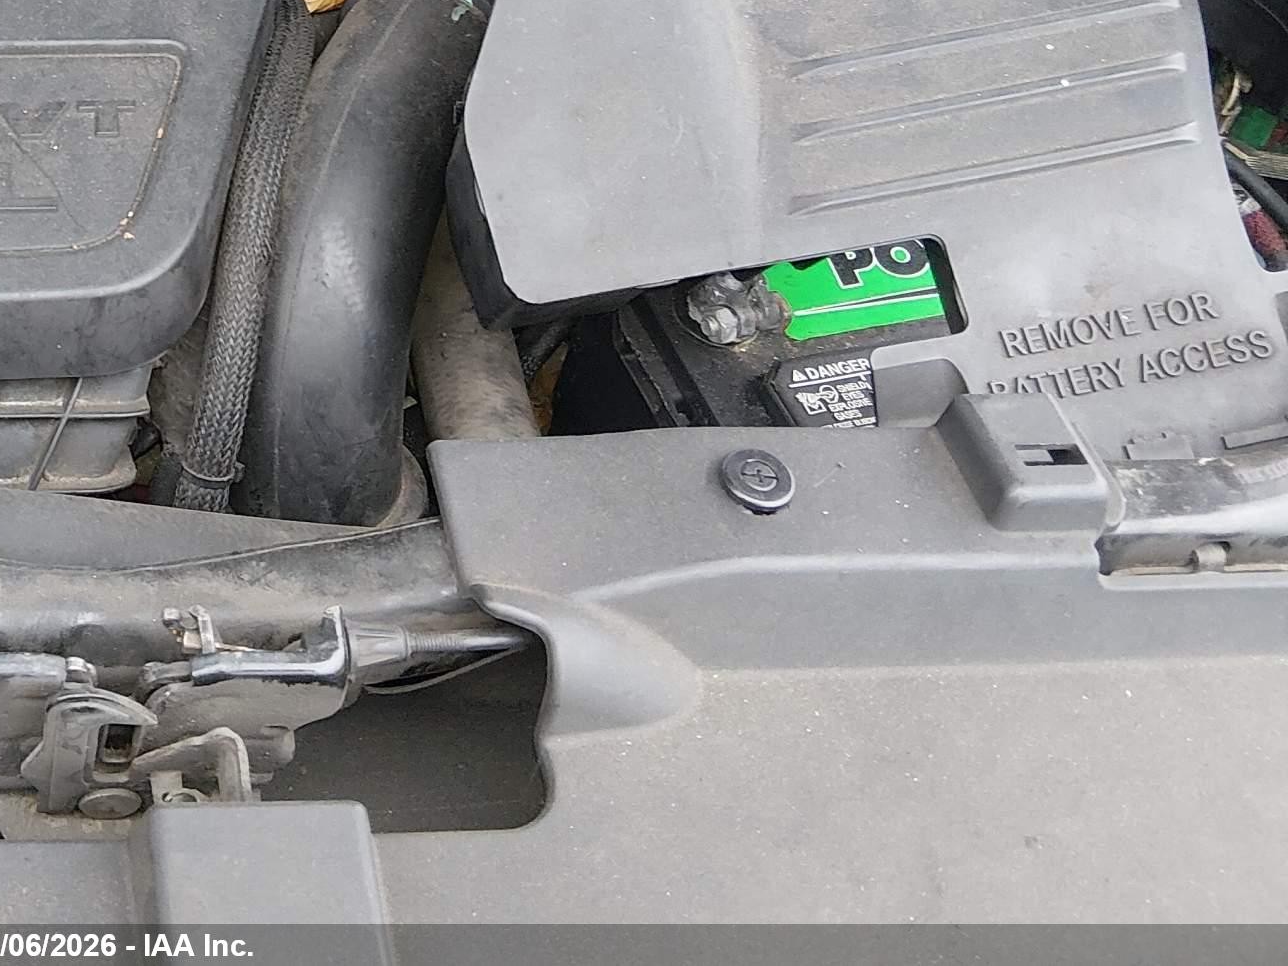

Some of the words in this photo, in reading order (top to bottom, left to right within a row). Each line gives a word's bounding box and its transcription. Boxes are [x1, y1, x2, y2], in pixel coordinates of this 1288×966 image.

[998, 308, 1142, 359] REMOVE
[1143, 291, 1220, 332] FOR
[805, 357, 872, 380] DANGER
[1139, 330, 1274, 384] ACCESS
